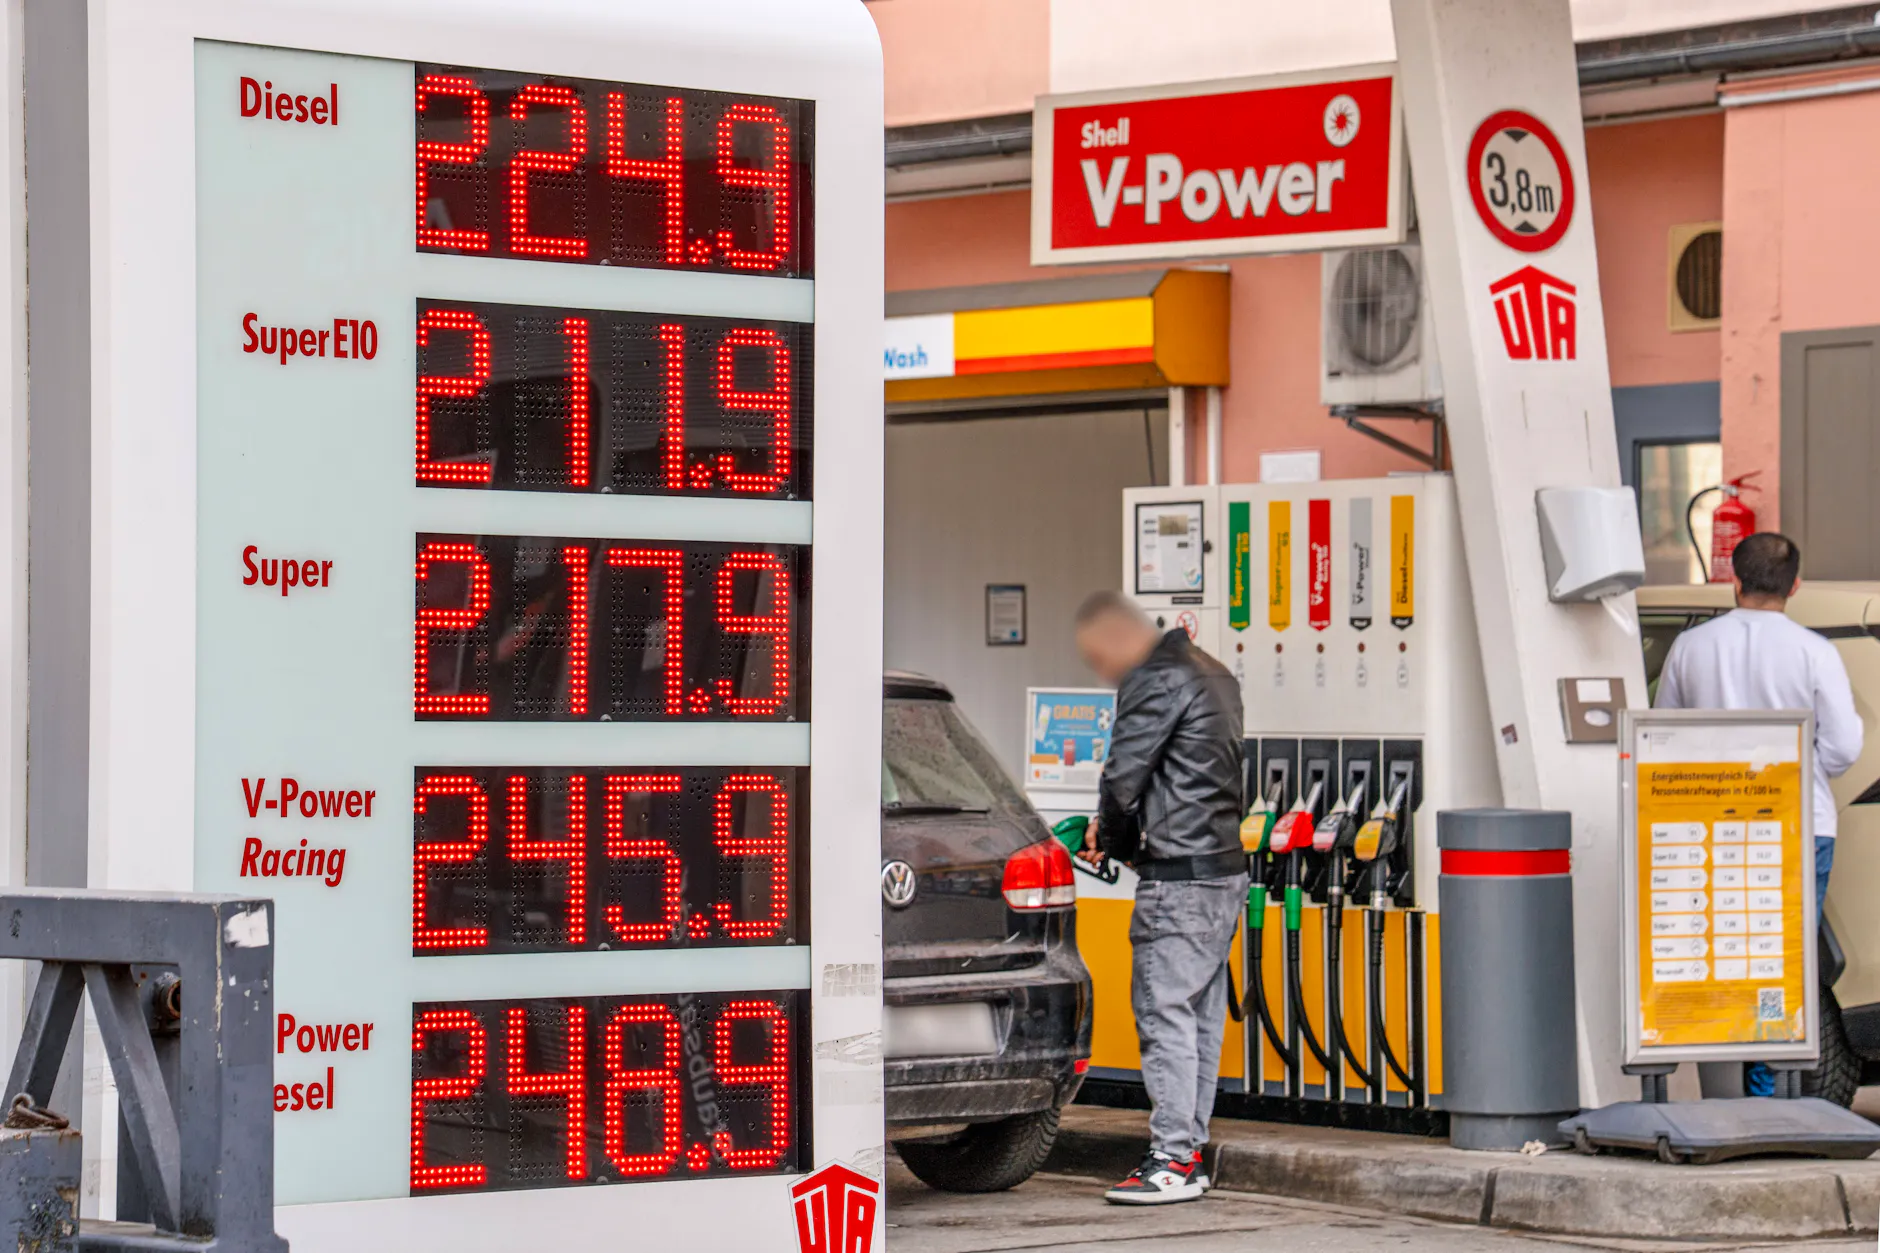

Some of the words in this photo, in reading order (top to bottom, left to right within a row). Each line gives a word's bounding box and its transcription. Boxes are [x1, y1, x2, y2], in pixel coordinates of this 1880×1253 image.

[241, 76, 338, 126] Diesel
[1081, 117, 1130, 149] Shell
[416, 73, 790, 271] 224.9
[1080, 153, 1345, 228] V-Power
[1490, 265, 1576, 360] UTA
[416, 309, 790, 493] 211.9
[241, 545, 333, 596] Super
[414, 542, 789, 715] 217.9
[241, 777, 375, 818] V-Power
[240, 837, 347, 887] Racing
[412, 775, 788, 949] 245.9
[277, 1013, 374, 1054] Power
[273, 1066, 334, 1112] esel
[410, 1000, 789, 1189] 248.9
[788, 1164, 881, 1253] UTA
